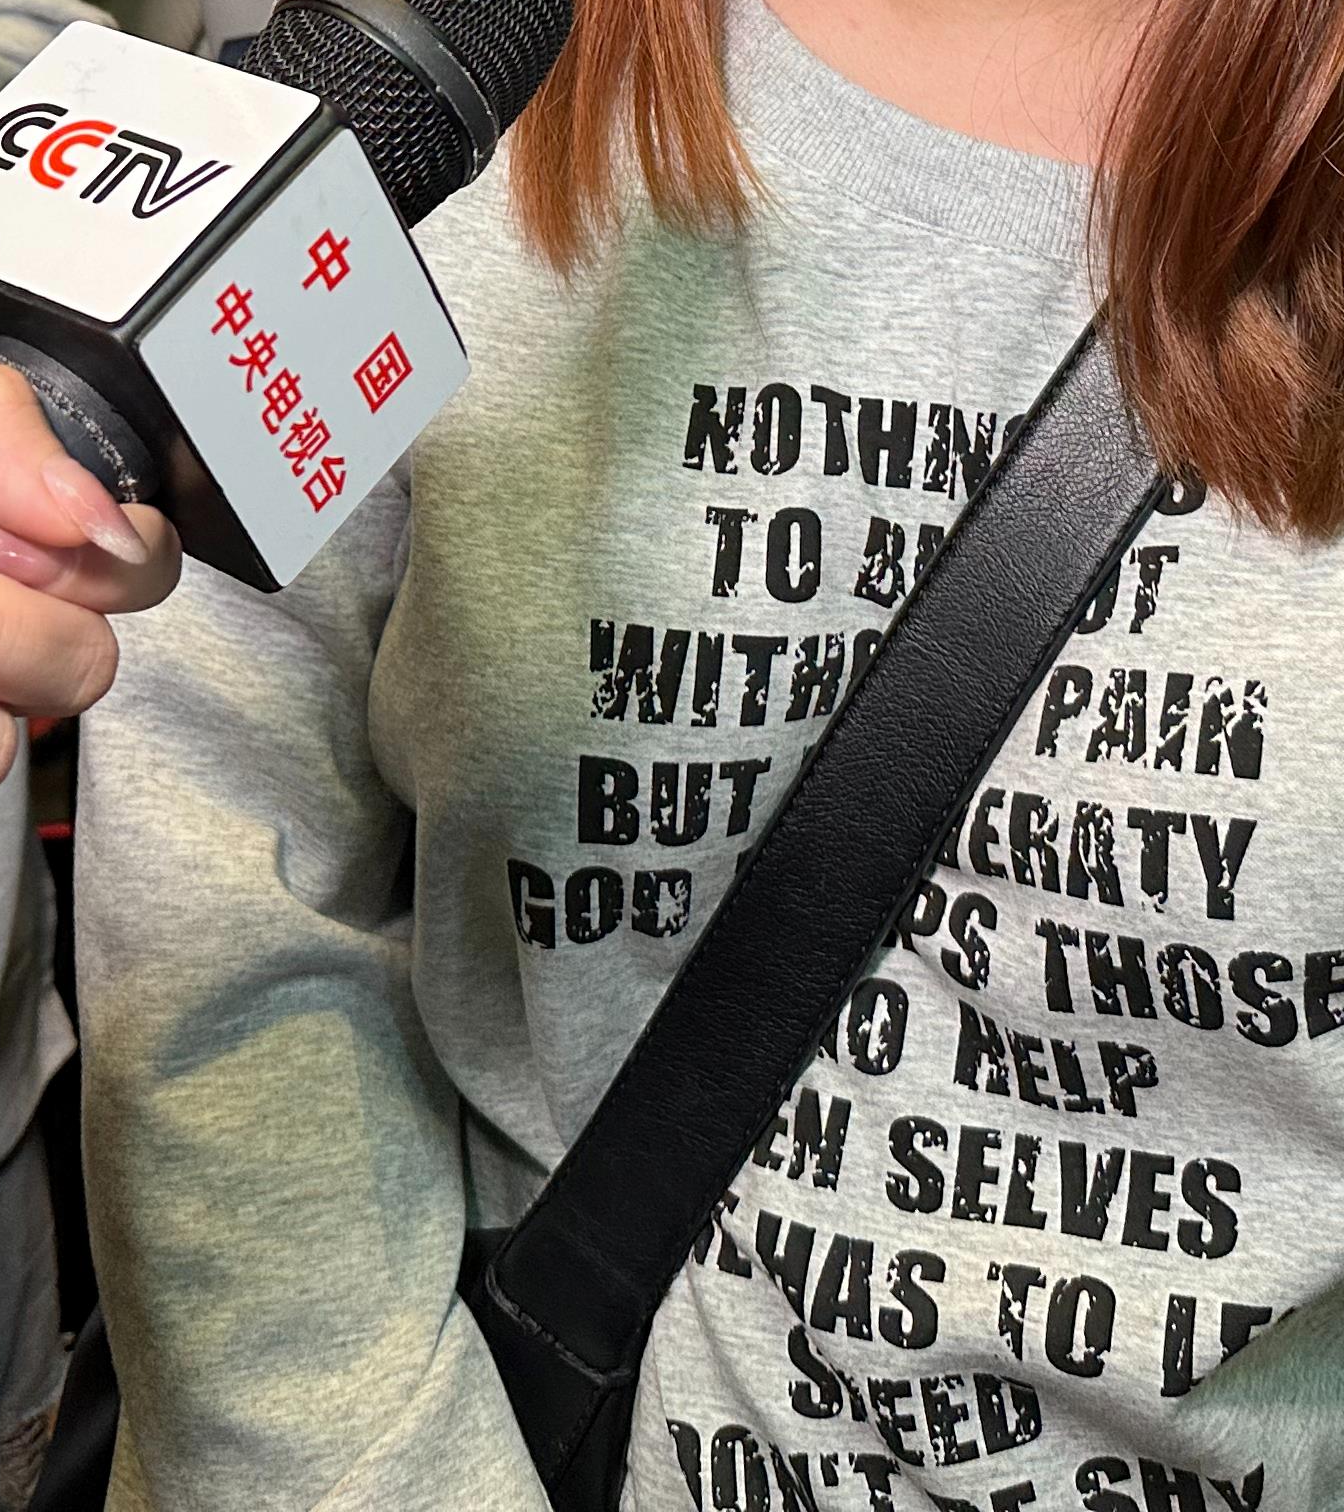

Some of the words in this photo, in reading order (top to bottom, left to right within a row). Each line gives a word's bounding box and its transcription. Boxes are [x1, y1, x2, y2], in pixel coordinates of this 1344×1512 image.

[301, 227, 414, 415] 中国
[210, 278, 348, 514] 中央电视台
[681, 382, 1027, 500] NOTHIN
[704, 506, 823, 604] TO
[589, 618, 886, 728] WITH
[1035, 663, 1268, 780] PAIN
[577, 754, 772, 847] BUT
[934, 787, 1258, 920] ERATY
[507, 858, 692, 949] GOD
[953, 999, 1158, 1118] HELP
[885, 1115, 1243, 1260] SELVES
[986, 1260, 1117, 1378] TO
